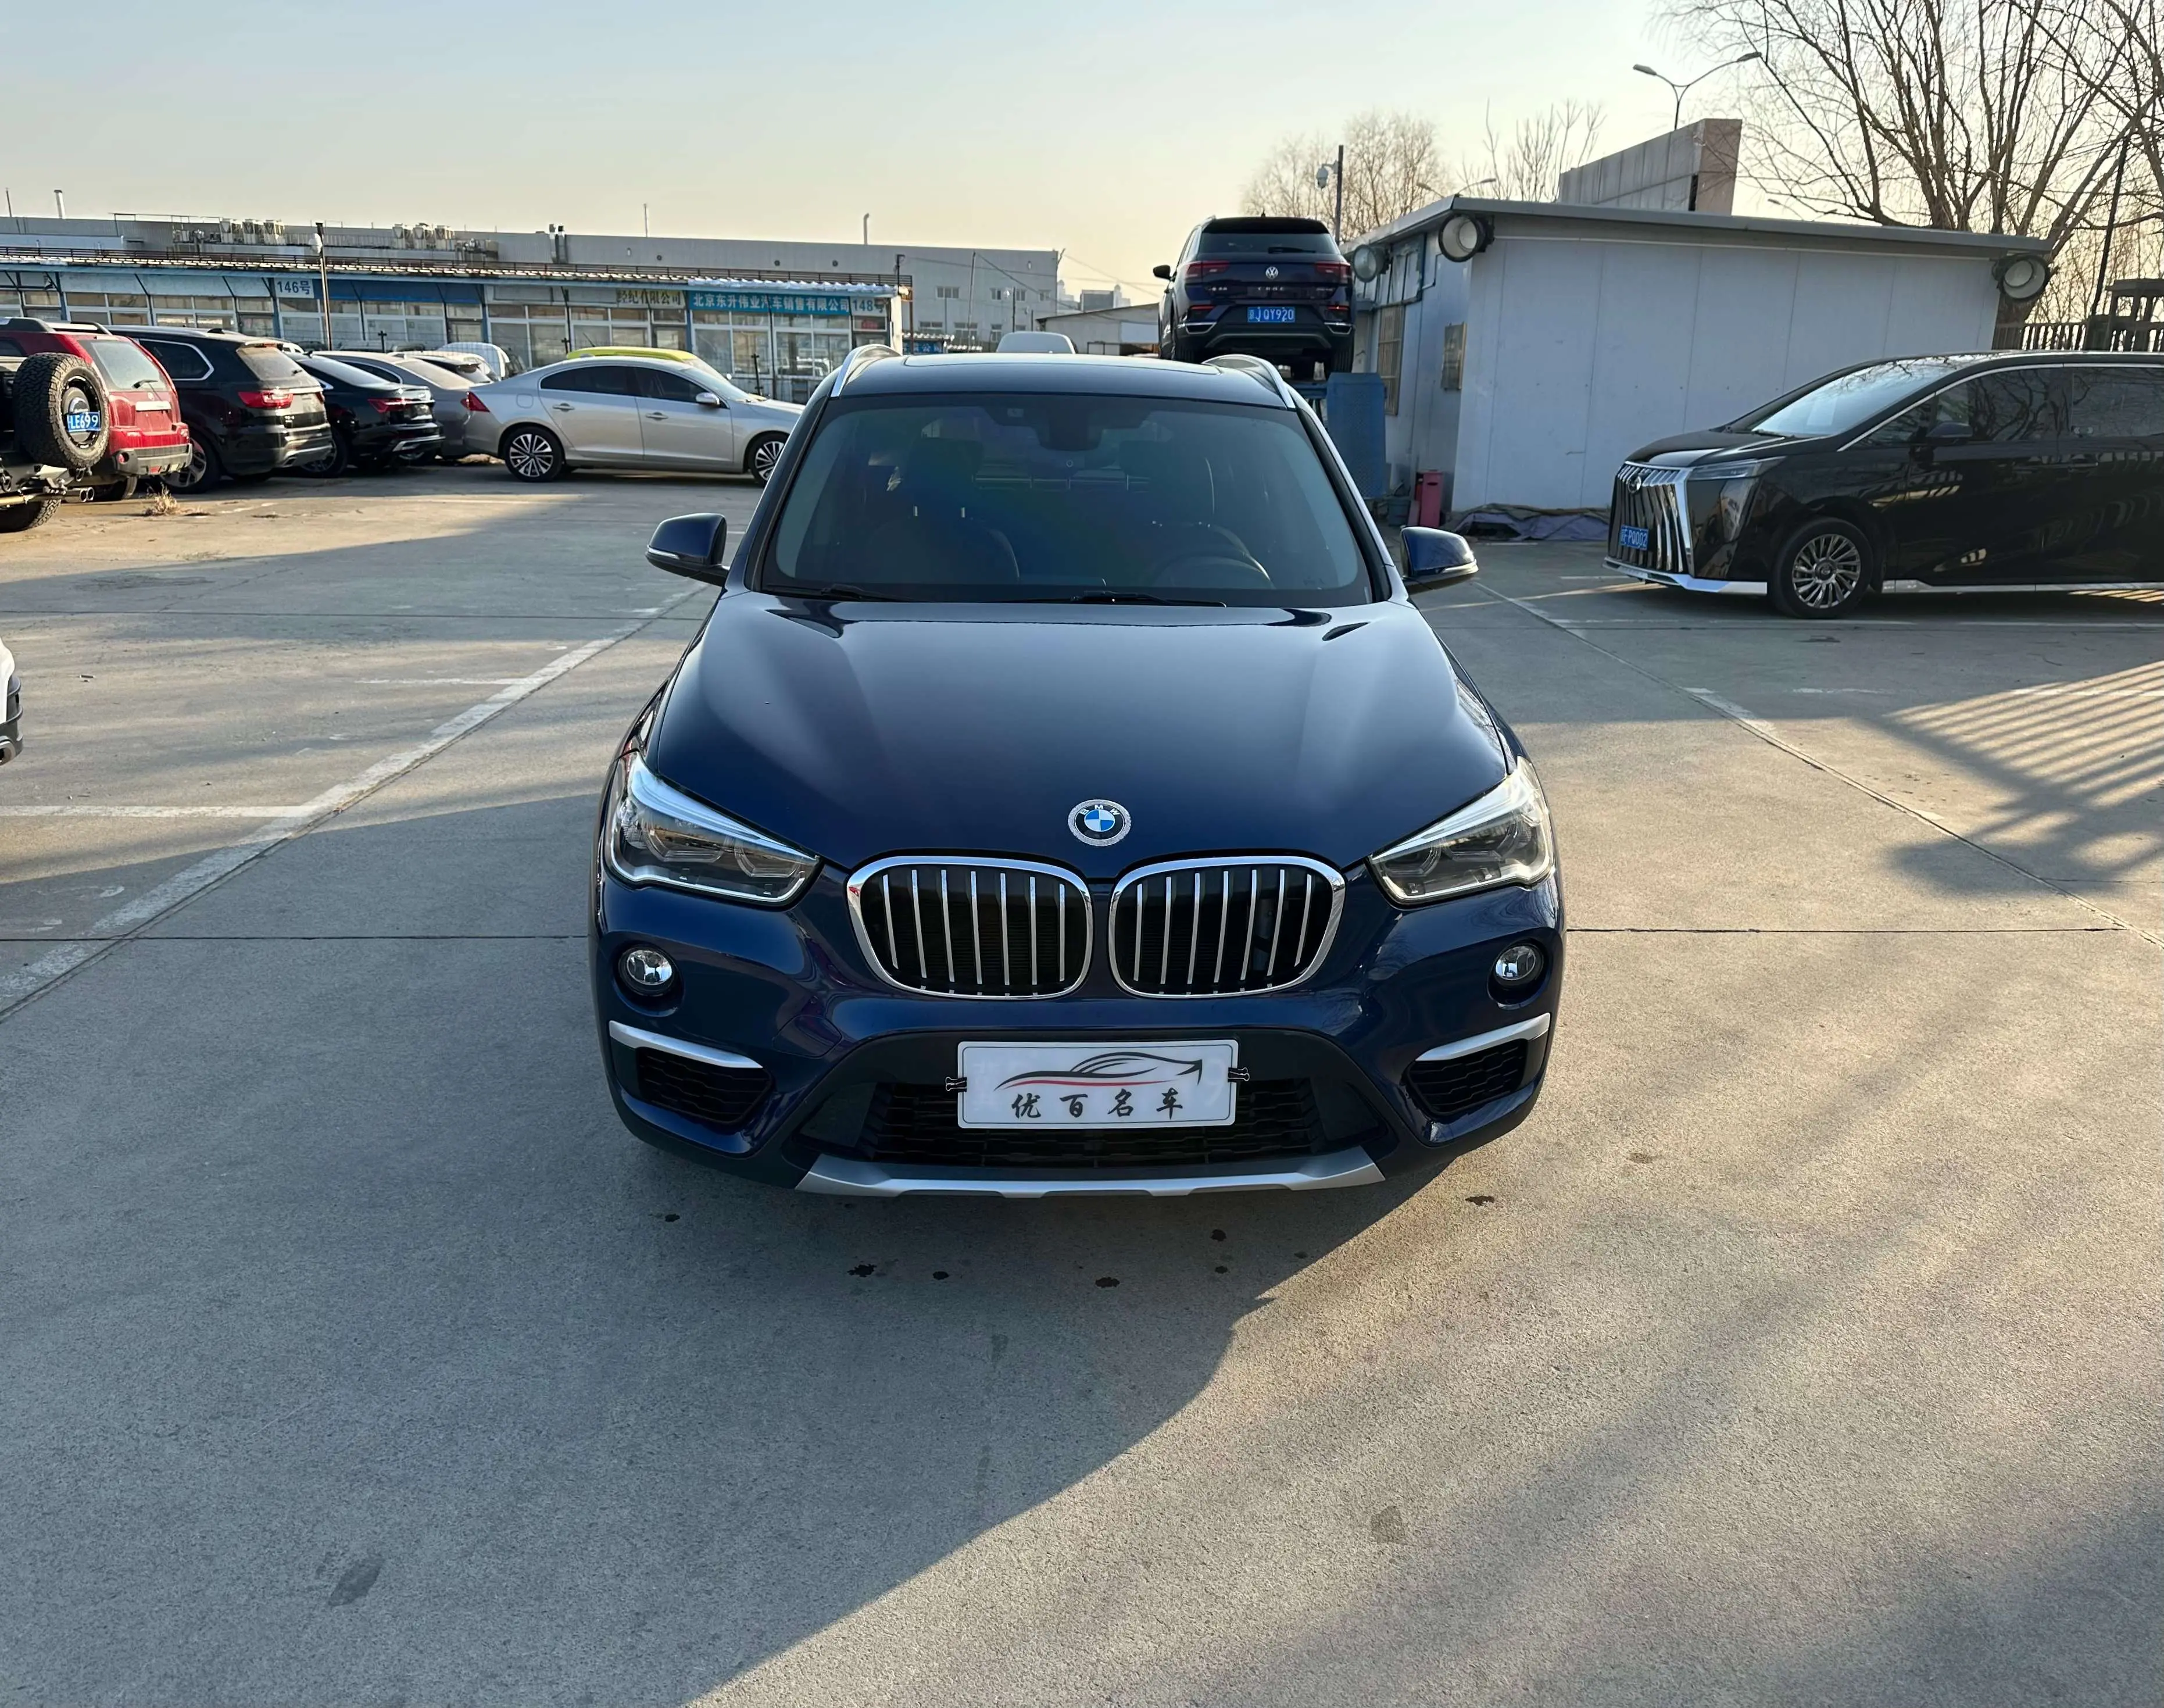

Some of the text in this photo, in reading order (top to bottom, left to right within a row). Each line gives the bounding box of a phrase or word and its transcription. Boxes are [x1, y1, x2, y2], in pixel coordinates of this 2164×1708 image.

[277, 281, 310, 295] 146号
[693, 292, 850, 312] 北京东升伟业汽车销售有限公司
[1079, 804, 1121, 816] BMW
[1011, 1087, 1183, 1120] 优百名车
